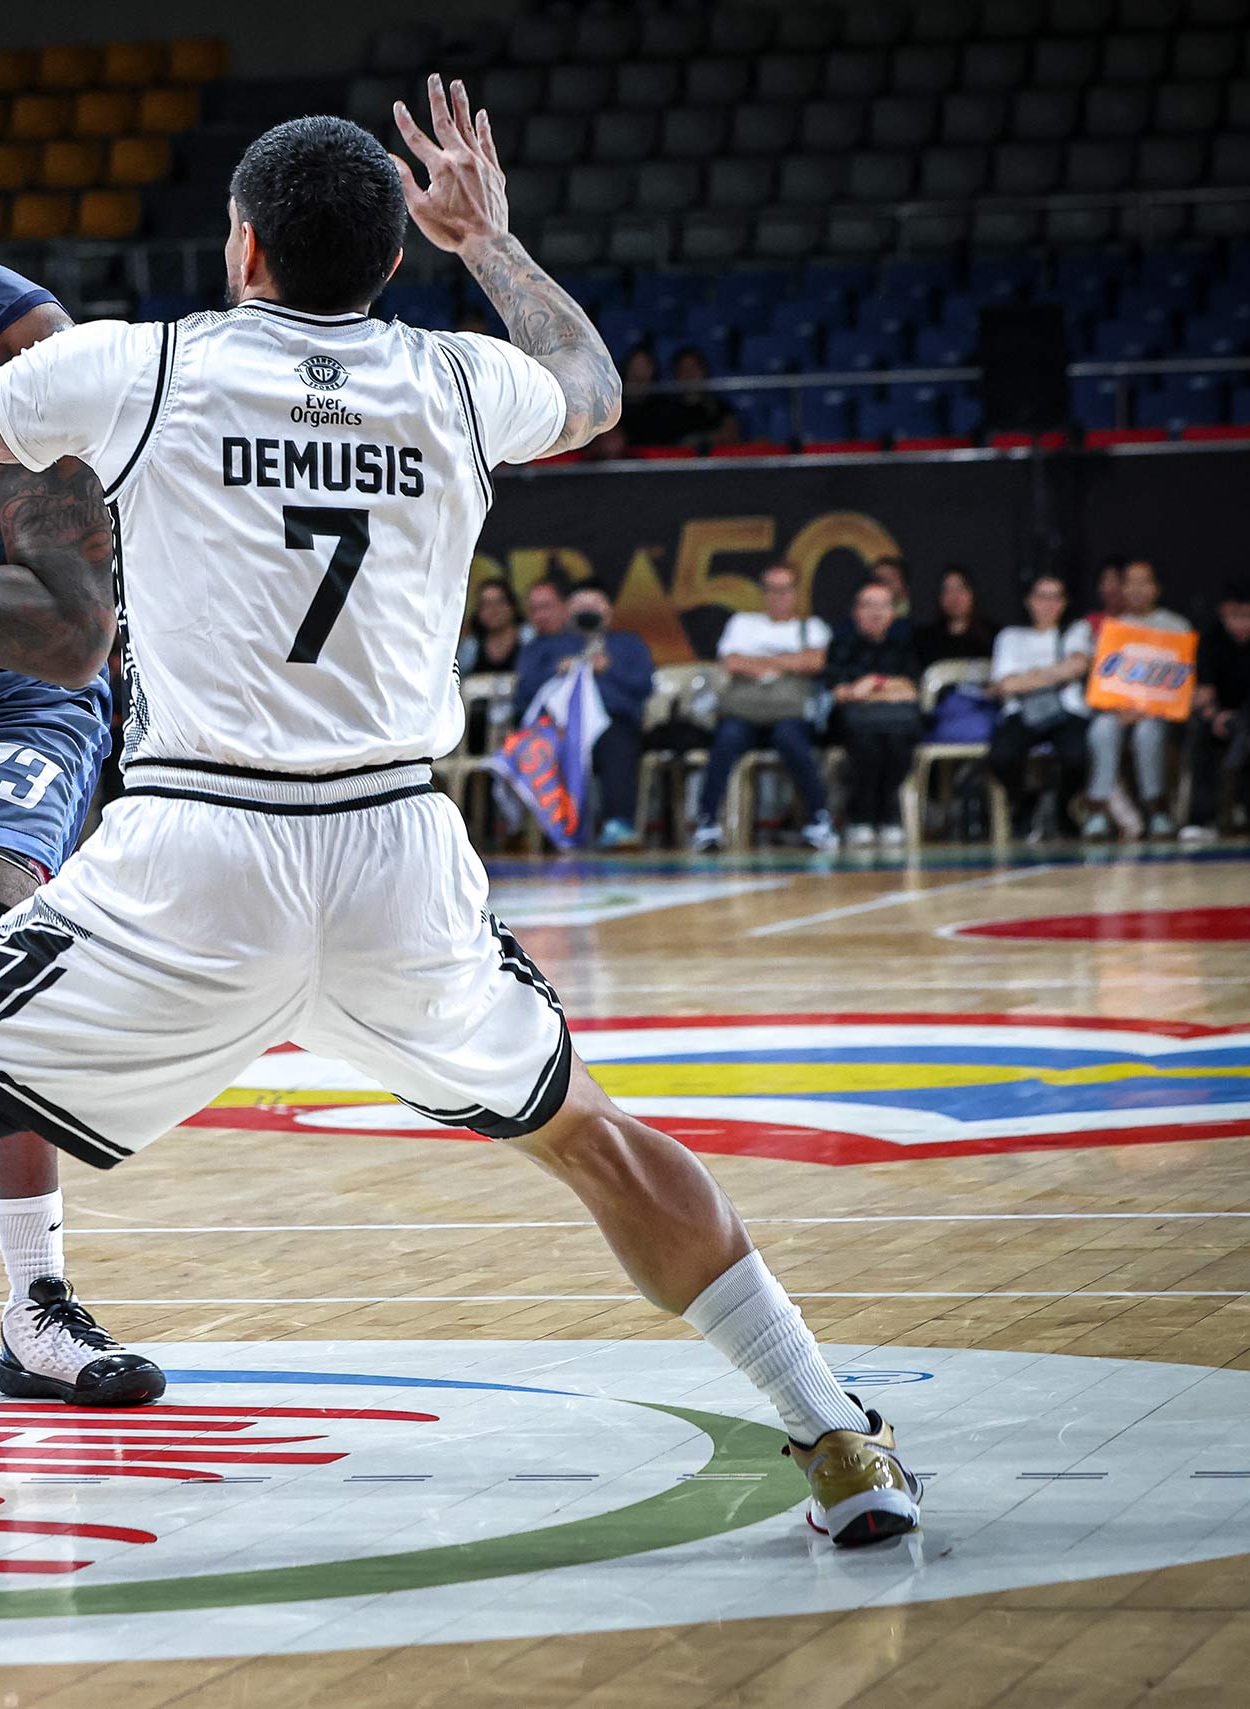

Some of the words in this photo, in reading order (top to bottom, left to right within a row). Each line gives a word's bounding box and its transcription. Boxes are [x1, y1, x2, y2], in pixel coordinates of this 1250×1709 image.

[291, 406, 362, 428] Organics
[306, 394, 342, 410] Ever
[223, 437, 424, 498] DEMUSIS
[283, 505, 370, 664] 7
